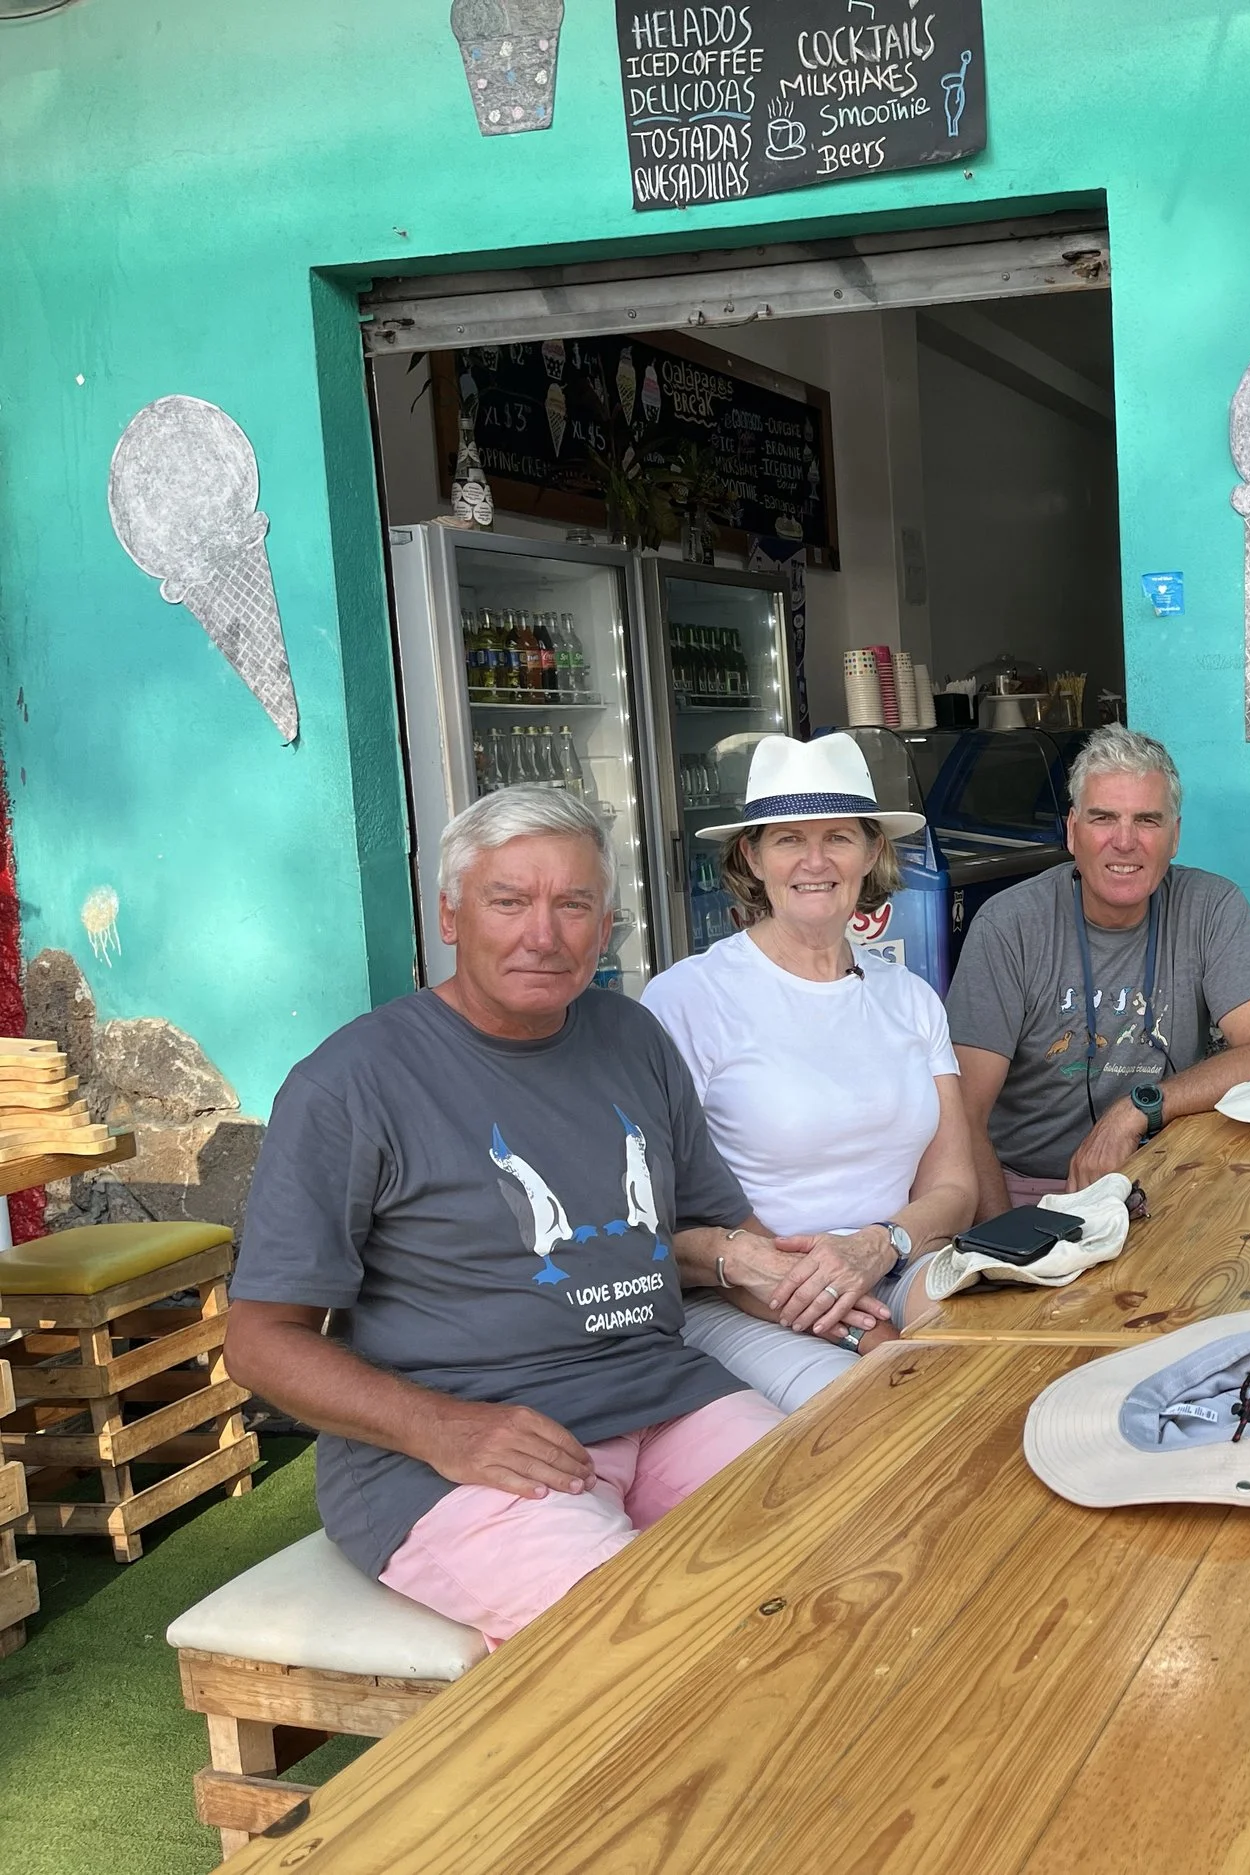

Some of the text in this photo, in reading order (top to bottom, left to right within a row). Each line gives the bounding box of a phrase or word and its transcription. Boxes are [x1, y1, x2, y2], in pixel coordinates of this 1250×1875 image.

[632, 5, 752, 50] HELADOS
[798, 14, 936, 70] COCKTAILS
[629, 75, 755, 117] DELICIOSAS
[780, 61, 918, 100] MILKSHAKES
[631, 122, 752, 160] TOSTADAS
[816, 136, 887, 175] Beers
[634, 160, 749, 203] QUESADILLAS
[566, 1272, 664, 1306] I LOVE BOOBIES
[585, 1303, 654, 1333] GALAPAGOS
